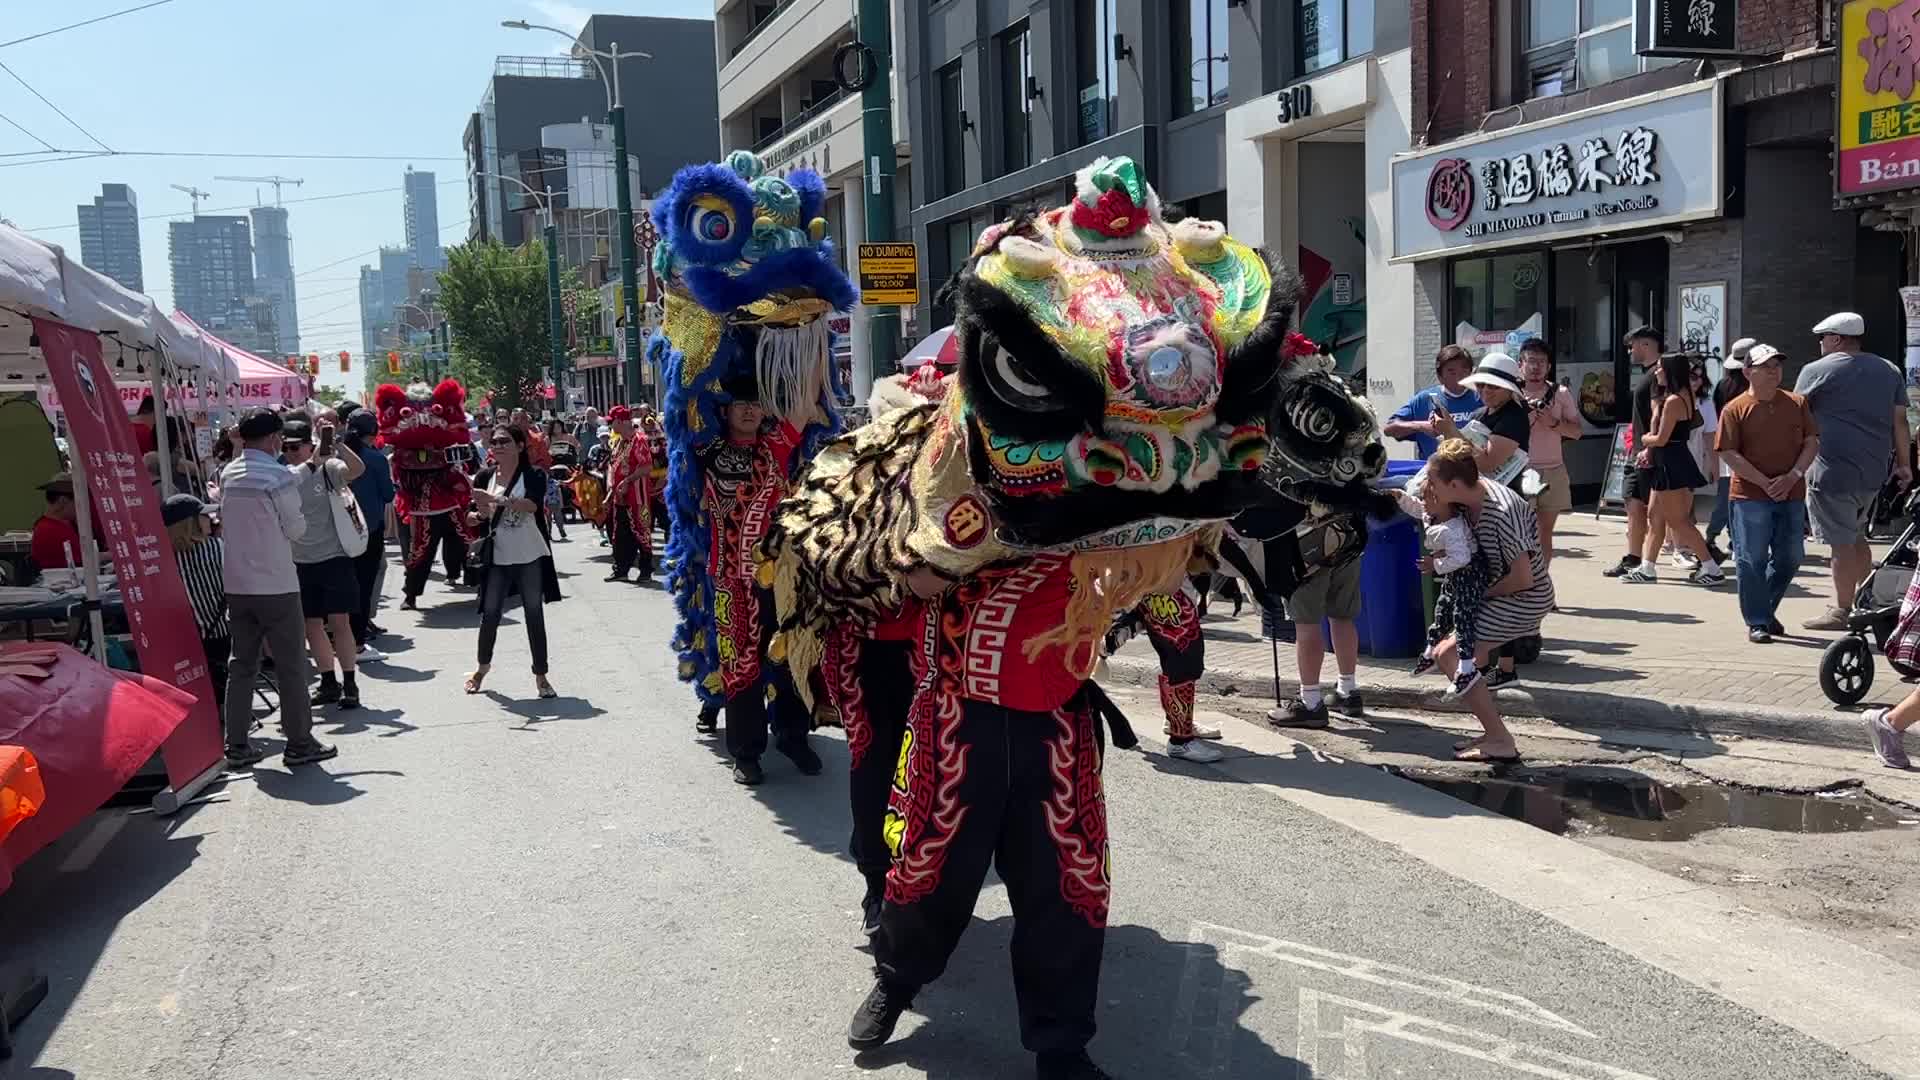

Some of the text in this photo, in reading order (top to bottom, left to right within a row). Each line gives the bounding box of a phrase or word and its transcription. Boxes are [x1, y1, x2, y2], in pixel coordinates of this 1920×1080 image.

[1278, 84, 1312, 123] 310
[1500, 126, 1660, 207] 過橋米線
[1465, 224, 1486, 237] SHI
[1486, 212, 1545, 234] MIAODAO
[1593, 202, 1617, 217] Rice
[1617, 195, 1658, 212] Noodle
[860, 246, 913, 257] NO DUMPING
